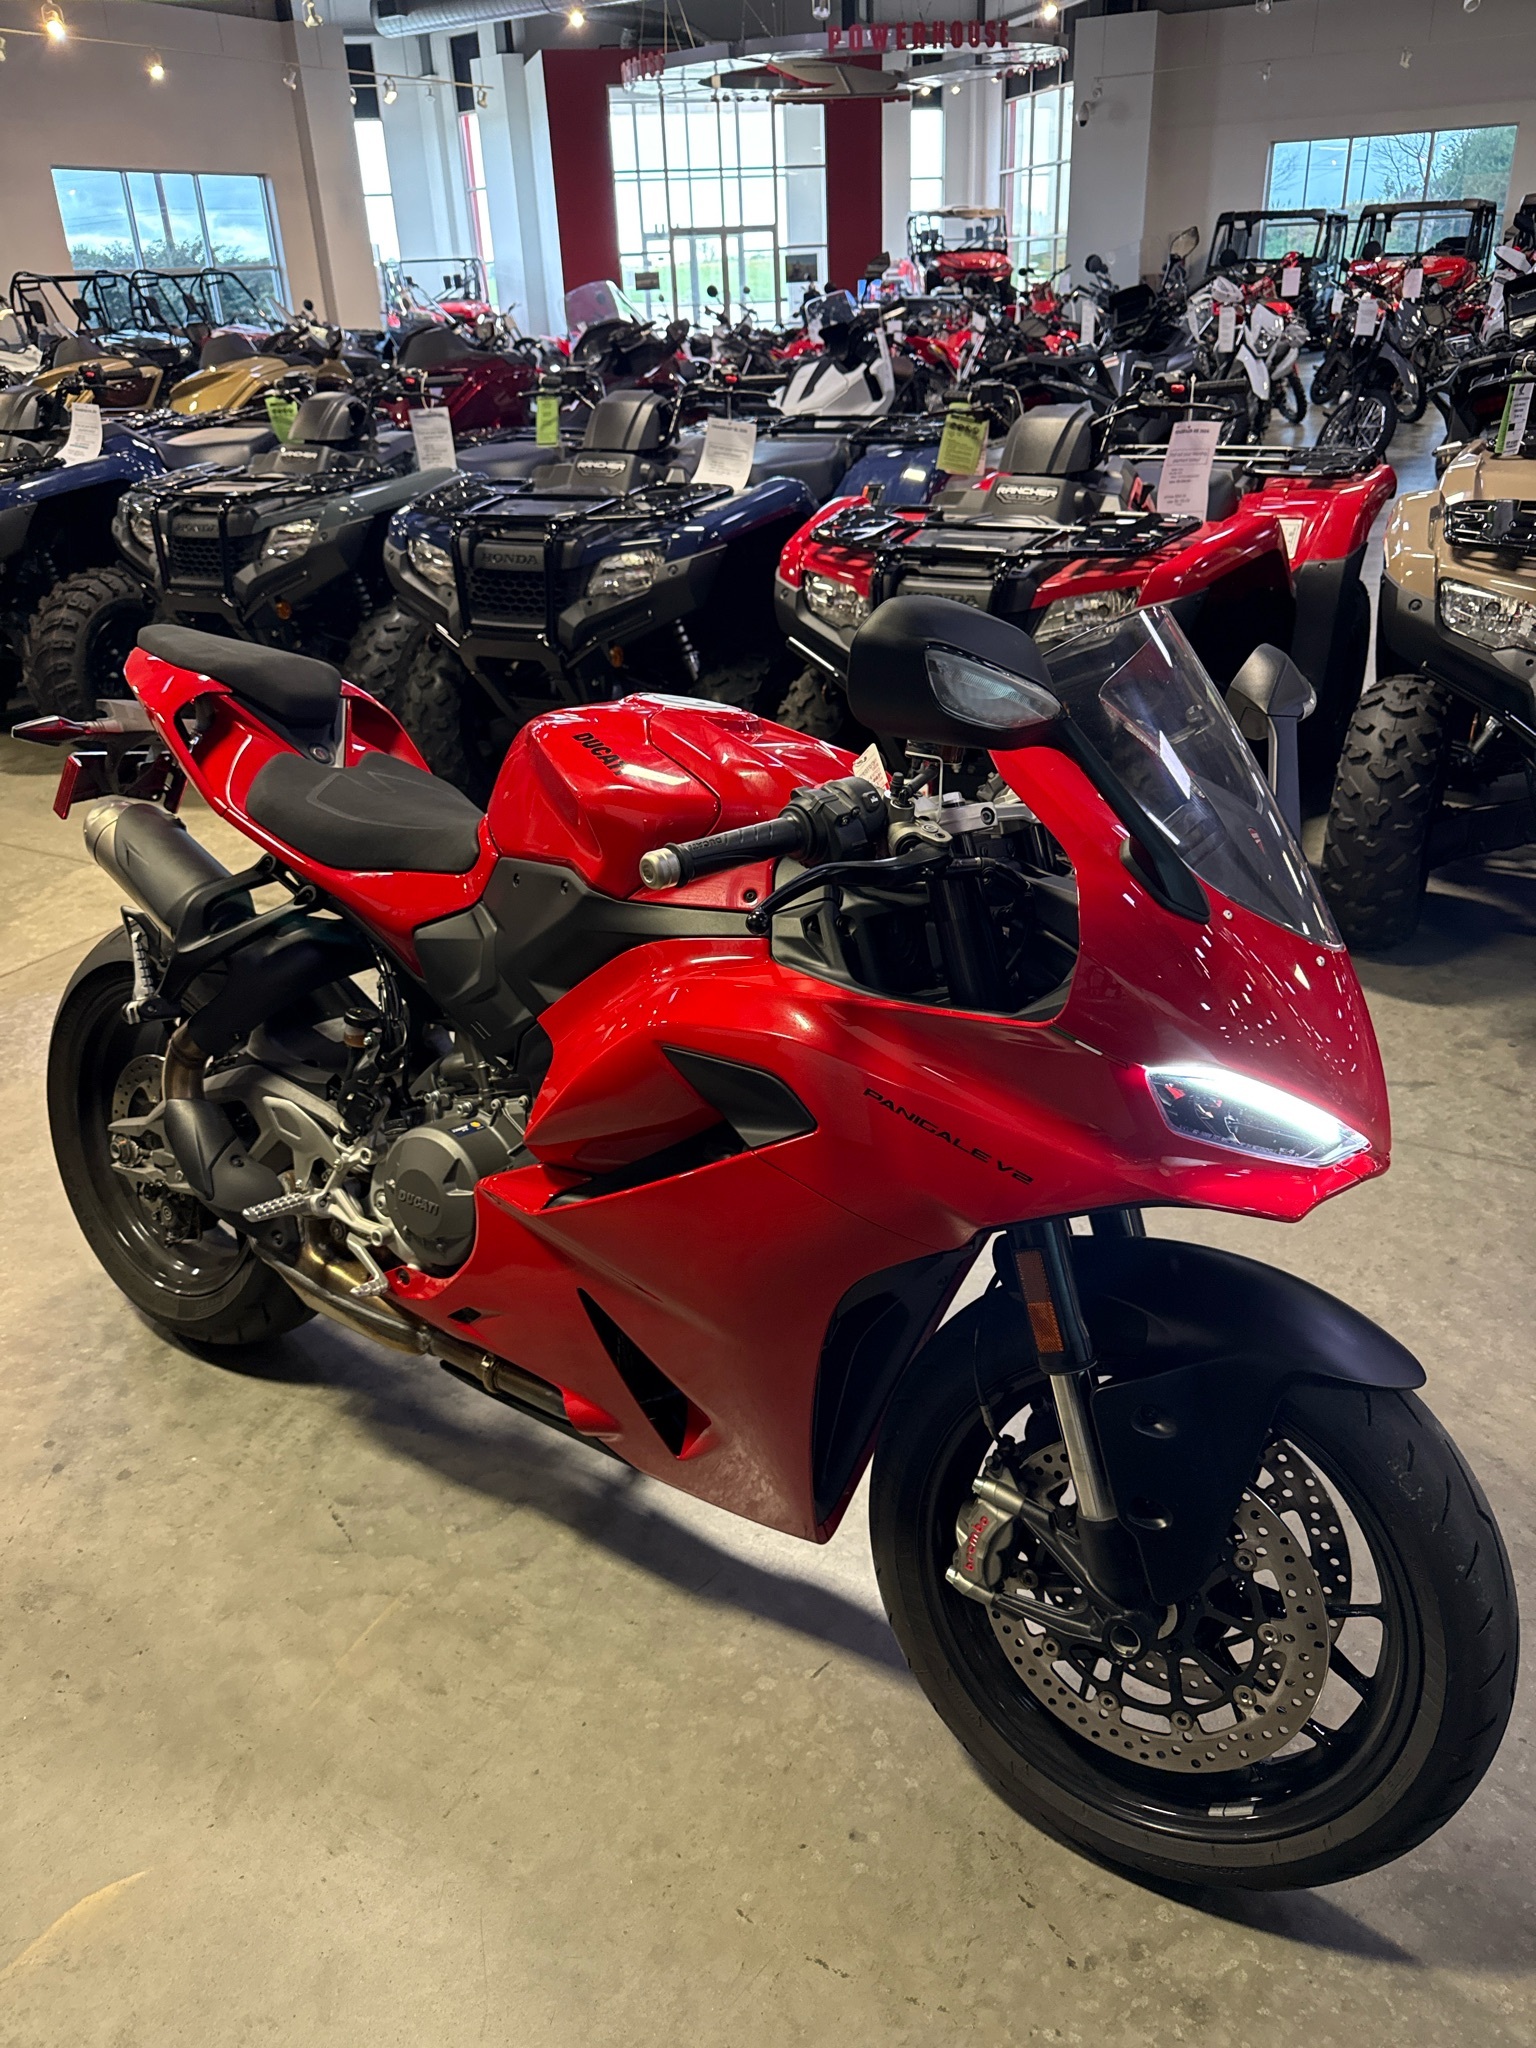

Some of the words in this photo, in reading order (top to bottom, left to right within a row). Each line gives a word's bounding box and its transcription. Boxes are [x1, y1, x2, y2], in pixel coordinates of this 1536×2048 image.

[828, 20, 1009, 53] POWERHOUSE
[996, 484, 1058, 498] RANCHER
[482, 553, 538, 564] HONDA
[863, 1087, 992, 1163] PANIGALE
[996, 1160, 1034, 1185] V2
[398, 1189, 439, 1216] DUCATI
[964, 1516, 989, 1571] brembo
